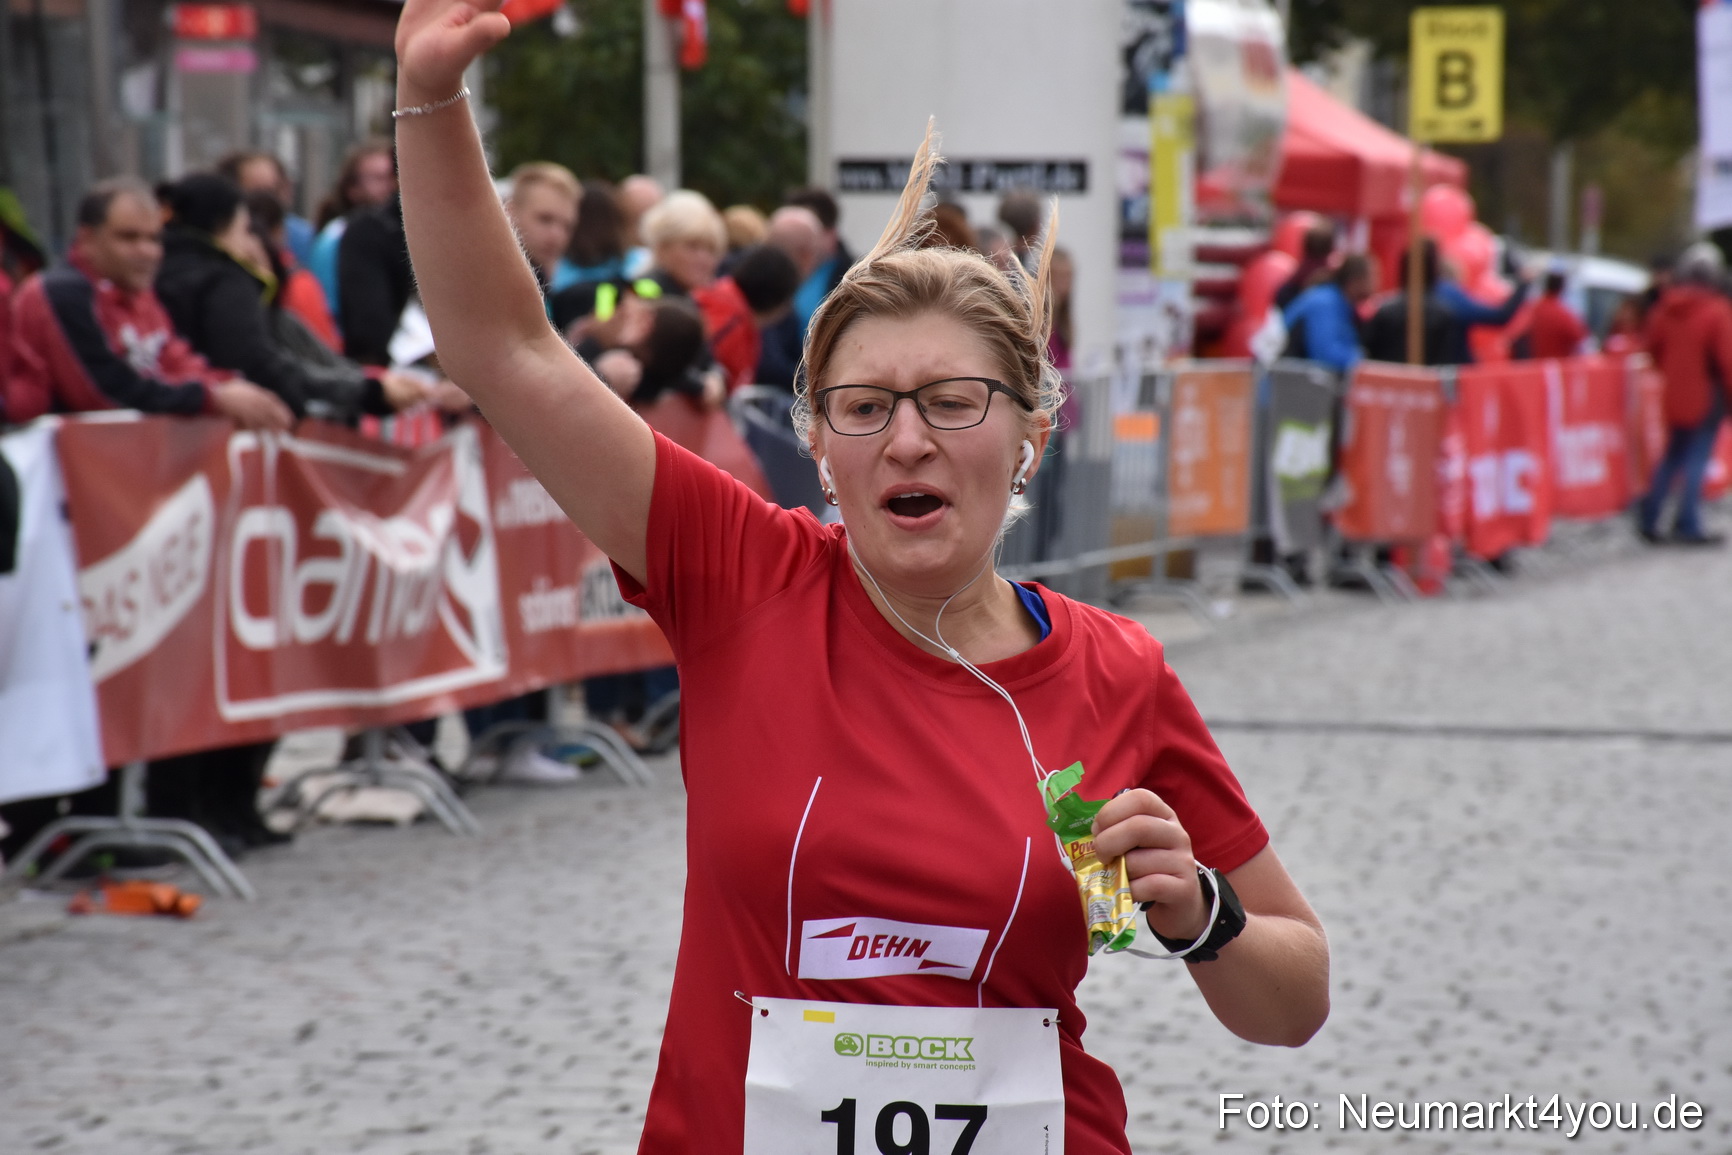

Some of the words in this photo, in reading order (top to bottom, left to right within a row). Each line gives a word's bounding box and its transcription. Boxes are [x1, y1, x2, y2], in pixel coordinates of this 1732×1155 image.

[1435, 50, 1477, 111] B
[847, 934, 932, 961] DEHN
[866, 1034, 975, 1061] BOCK
[865, 1059, 899, 1069] inspired
[901, 1060, 911, 1070] by
[913, 1062, 937, 1070] smart
[939, 1063, 976, 1071] concepts
[821, 1098, 988, 1155] 197
